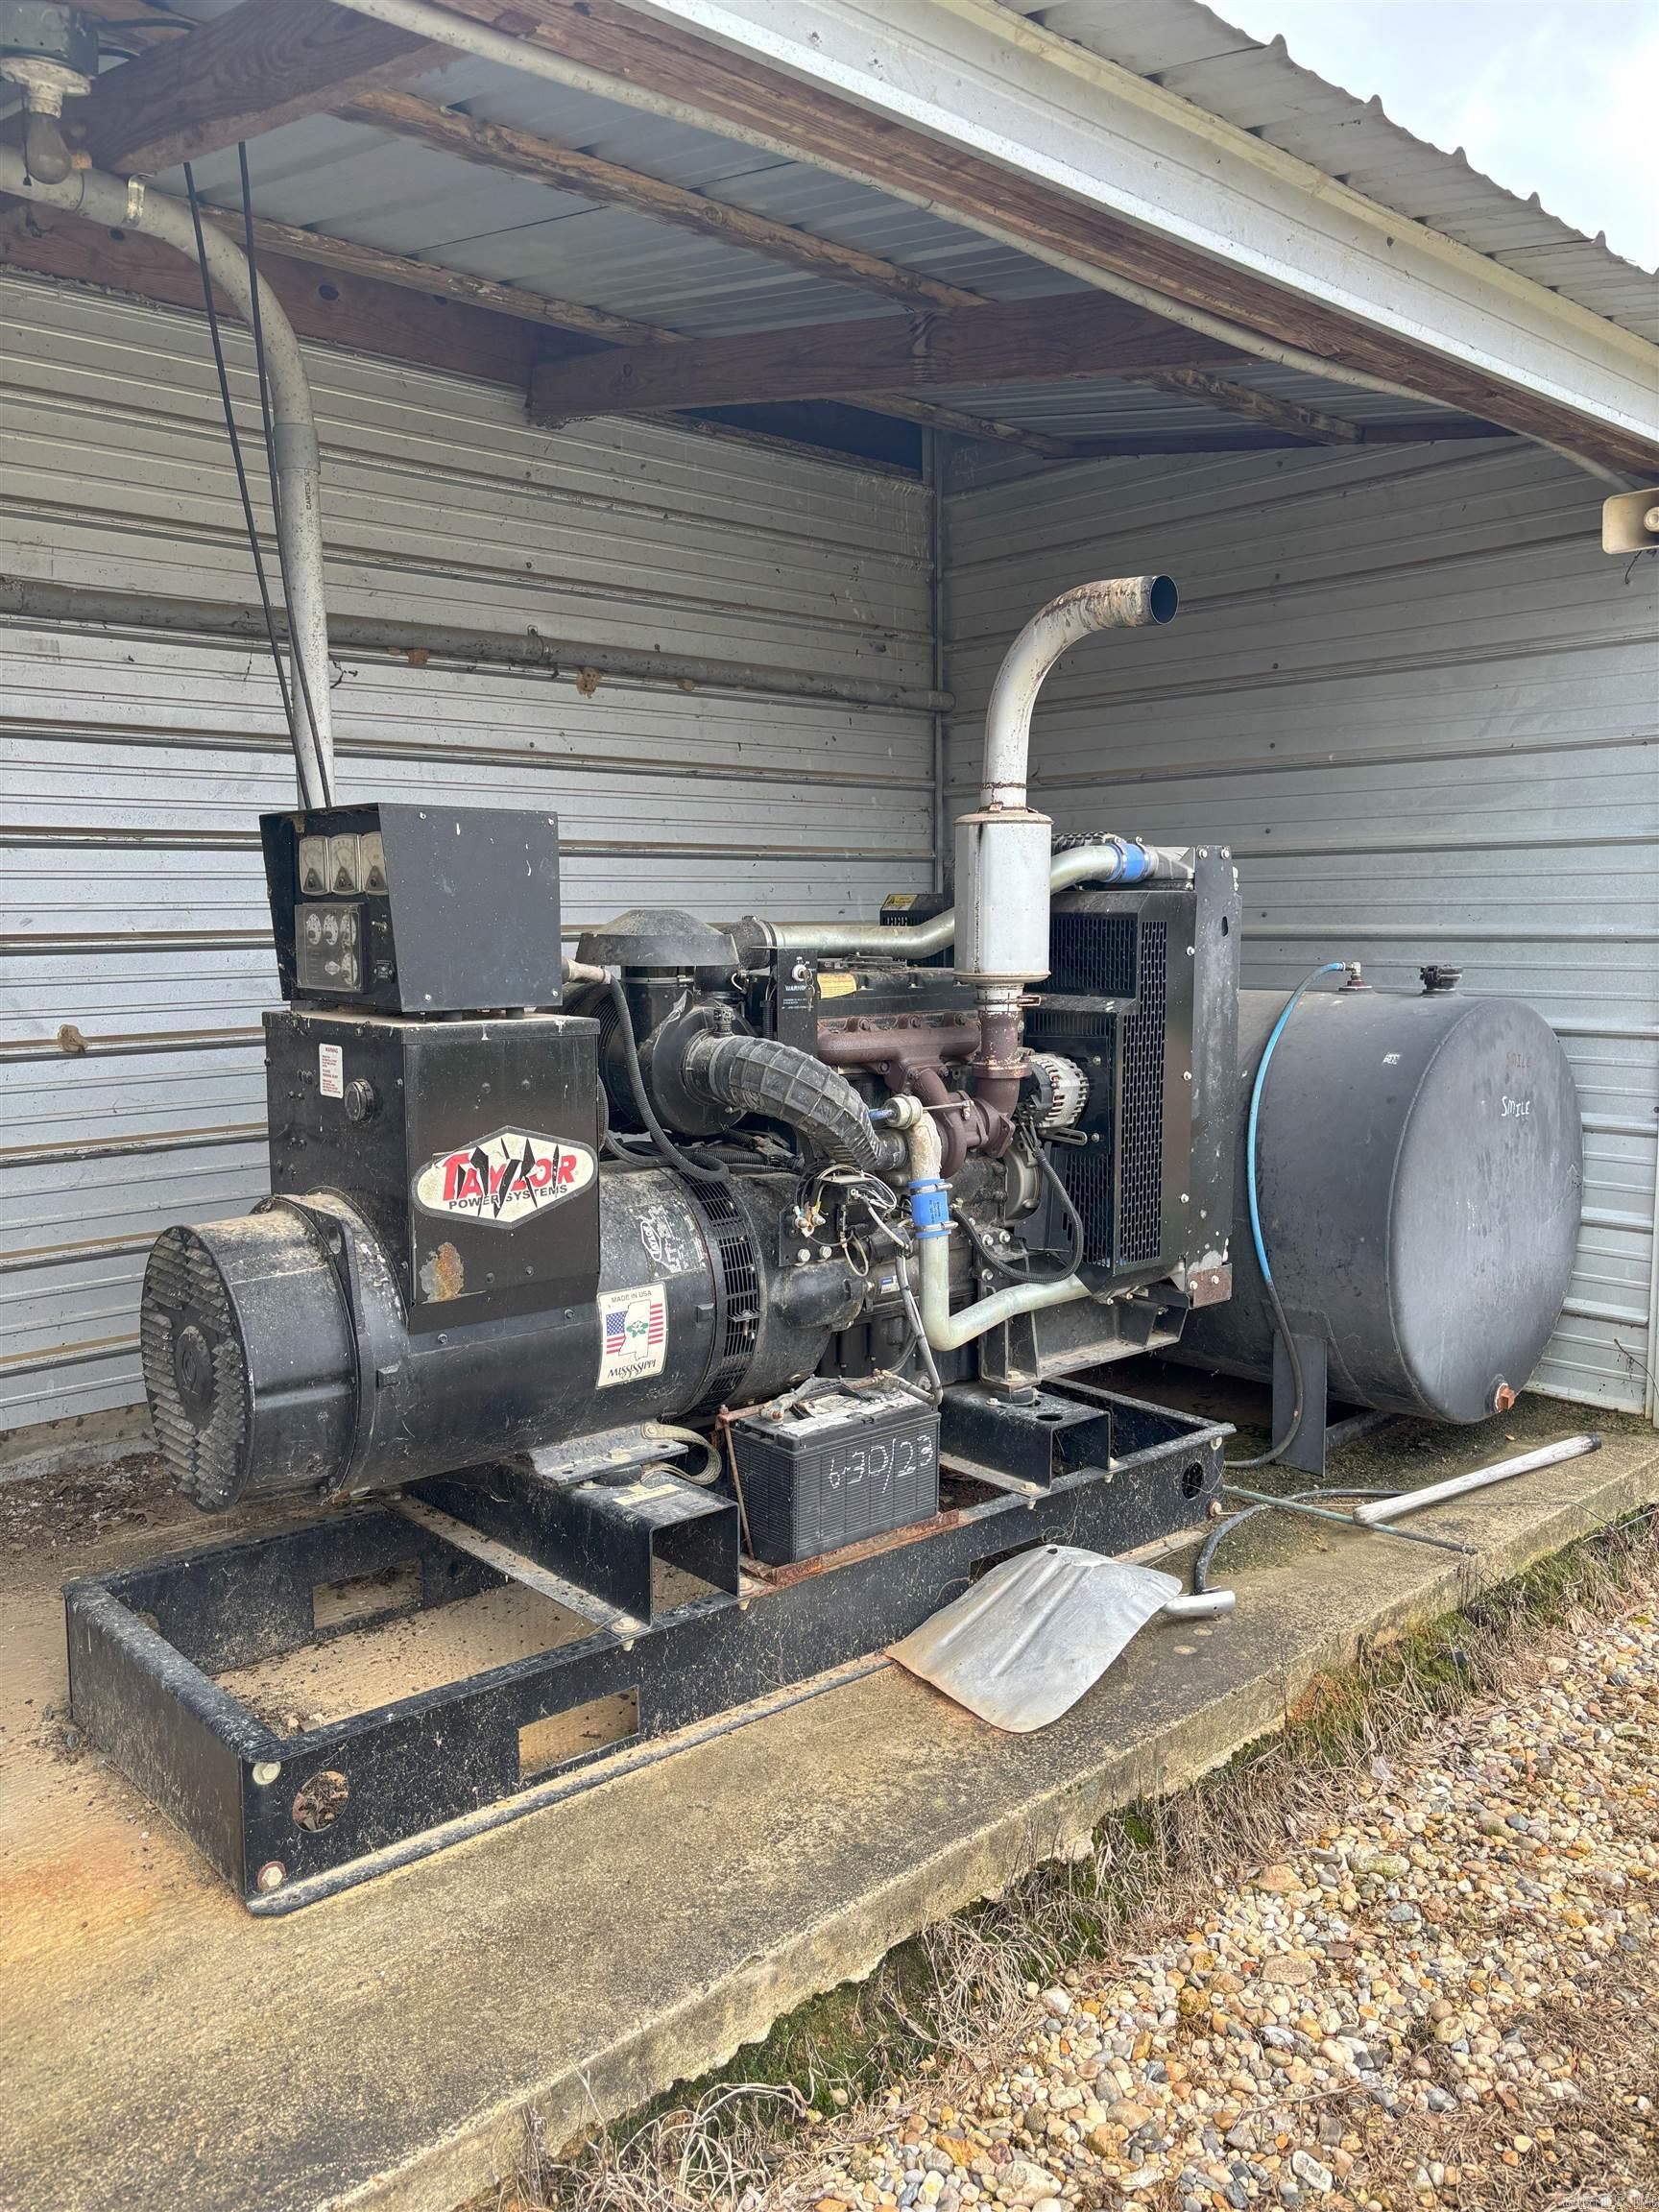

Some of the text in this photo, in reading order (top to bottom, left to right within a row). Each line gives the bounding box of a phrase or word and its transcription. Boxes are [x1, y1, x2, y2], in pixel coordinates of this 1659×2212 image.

[1501, 1095, 1530, 1118] SMILE
[448, 1184, 568, 1210] POWER SYSTEMS
[611, 1293, 630, 1304] MADE
[638, 1289, 652, 1298] USA
